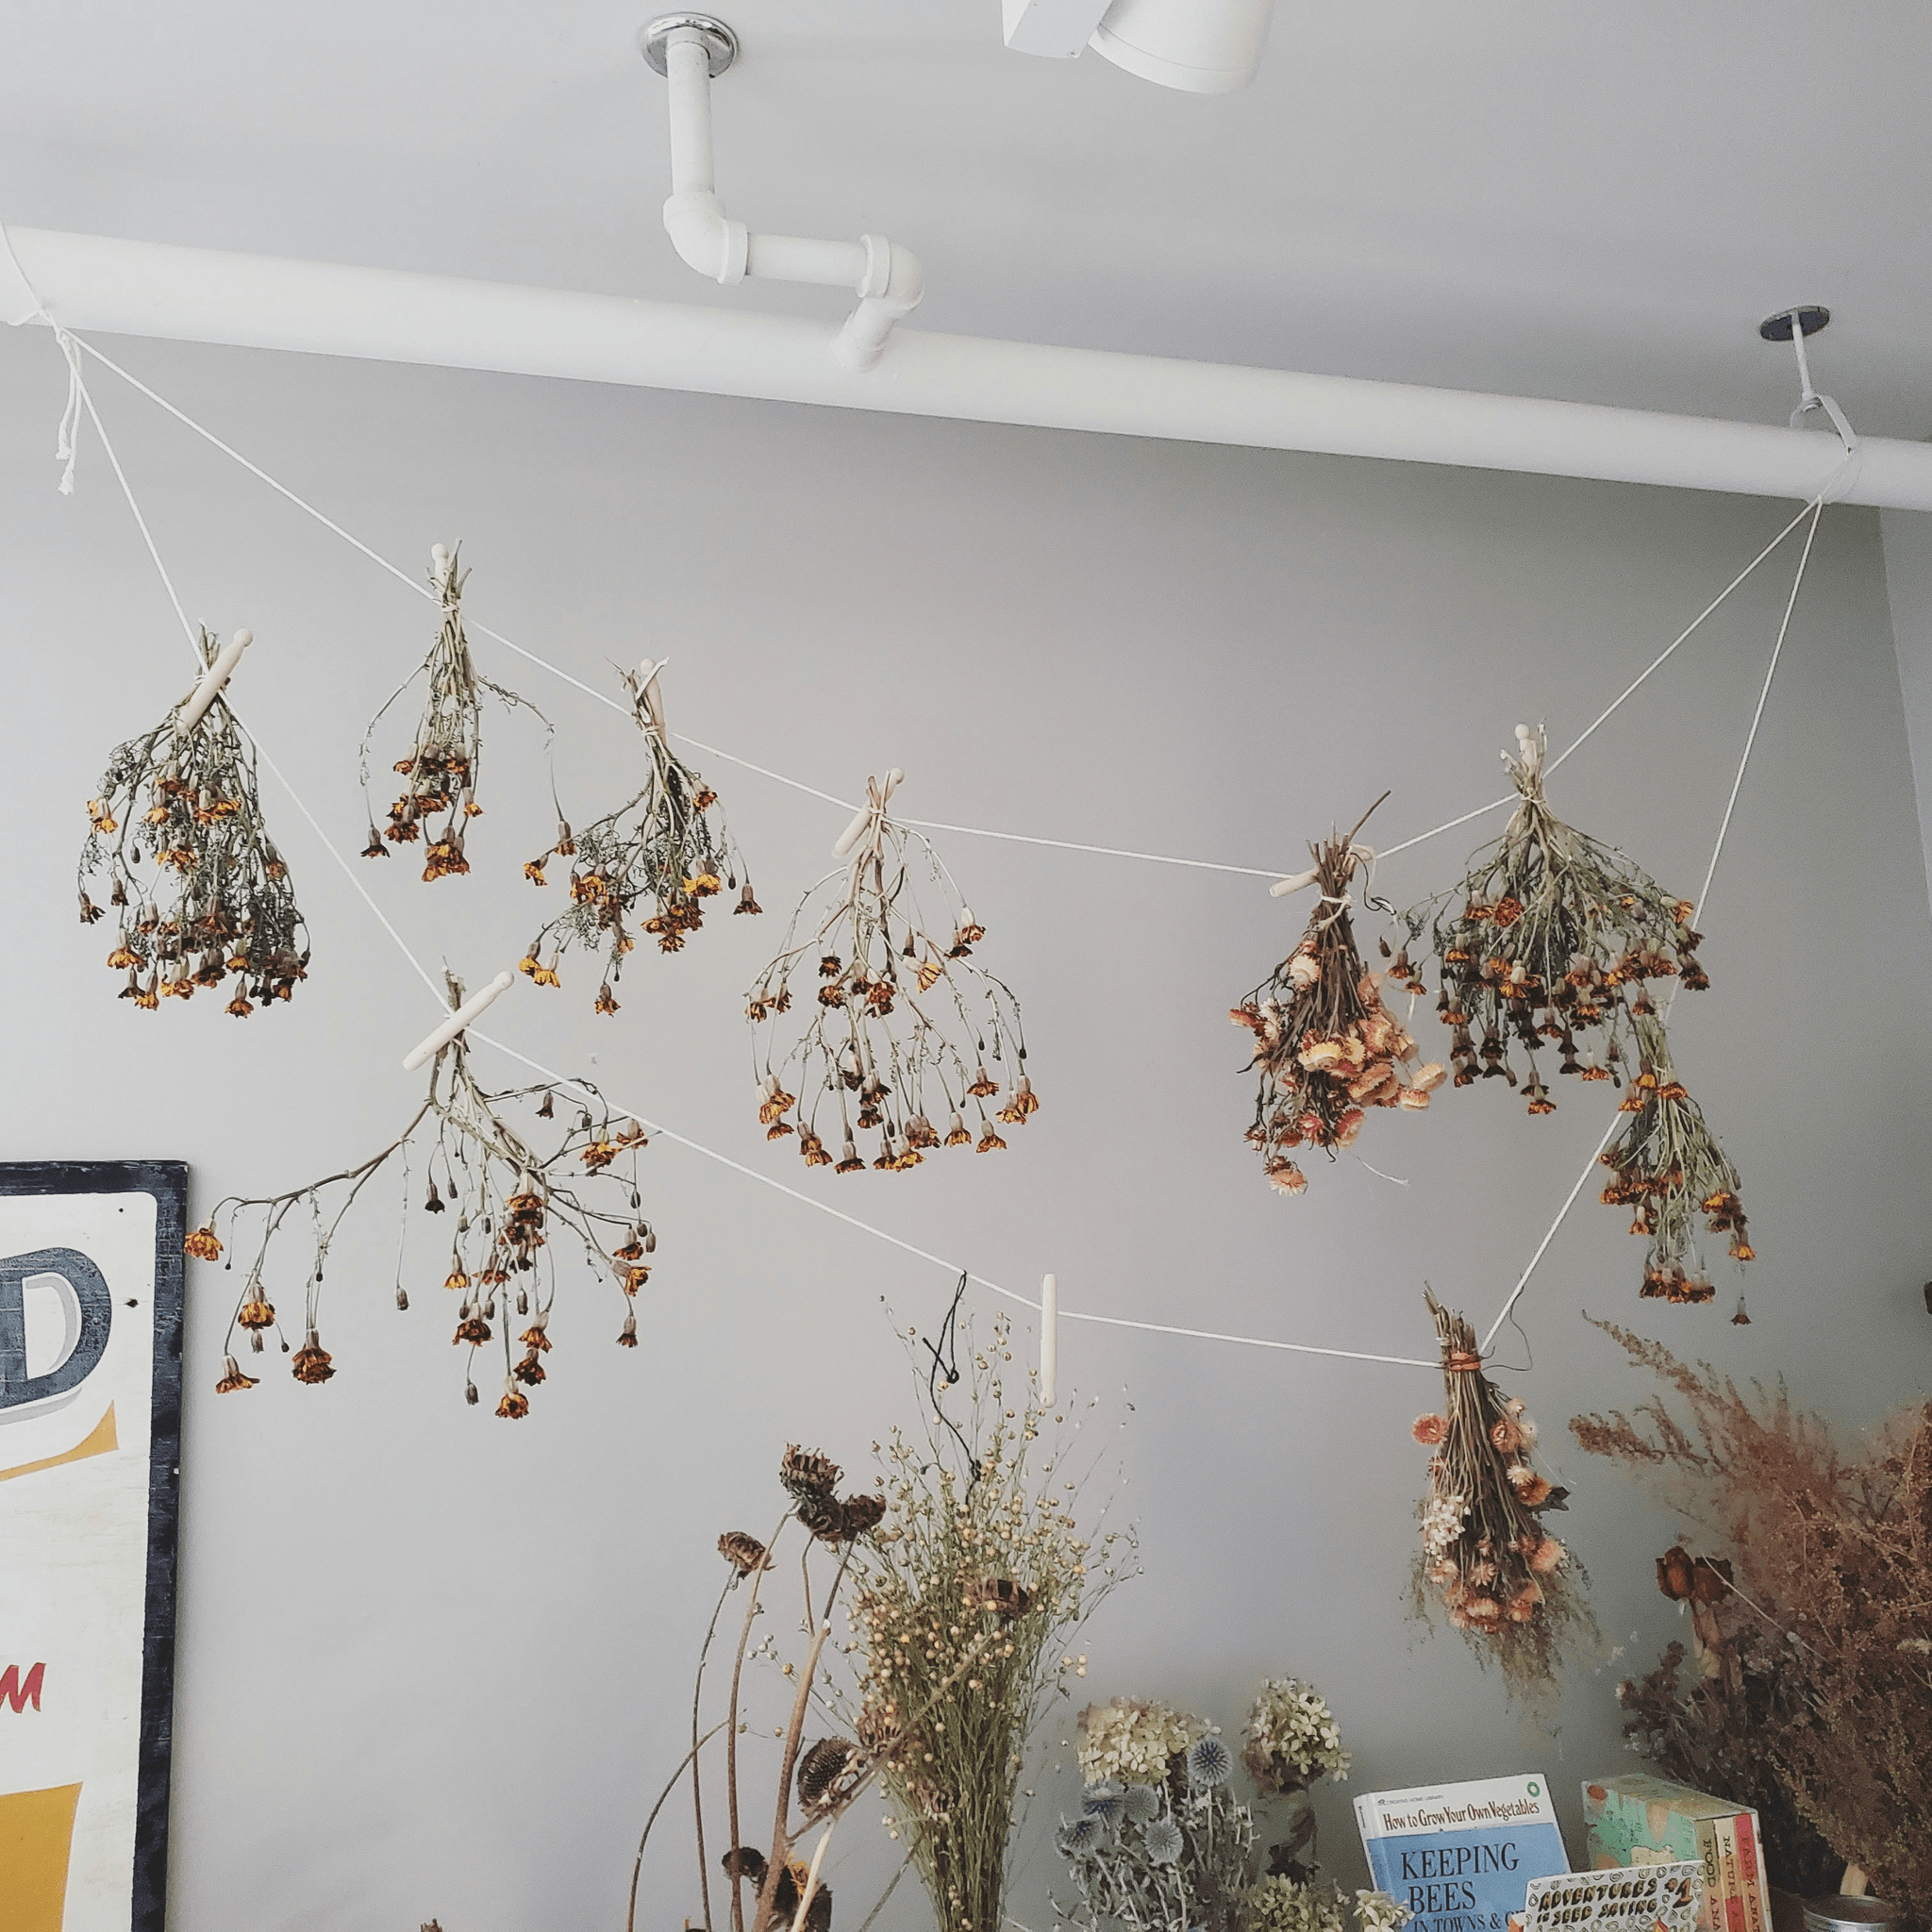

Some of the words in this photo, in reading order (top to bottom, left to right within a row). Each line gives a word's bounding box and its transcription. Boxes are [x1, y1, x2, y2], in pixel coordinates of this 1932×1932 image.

[1383, 1812, 1406, 1831] How
[1407, 1813, 1418, 1828] to
[1419, 1808, 1446, 1827] Grow
[1443, 1806, 1467, 1824] Your
[1468, 1803, 1491, 1821] Own
[1489, 1798, 1541, 1822] Vegetables
[1401, 1842, 1520, 1880] KEEPING
[1704, 1839, 1717, 1888] FOOD
[1723, 1836, 1739, 1904] NATURE
[1741, 1837, 1756, 1887] FARM
[1408, 1880, 1476, 1915] BEES
[1538, 1877, 1657, 1912] ADVENTURES
[1551, 1905, 1592, 1926] SEED
[1597, 1898, 1657, 1919] SAVING
[1433, 1914, 1486, 1932] TOWNS
[1490, 1912, 1502, 1930] &
